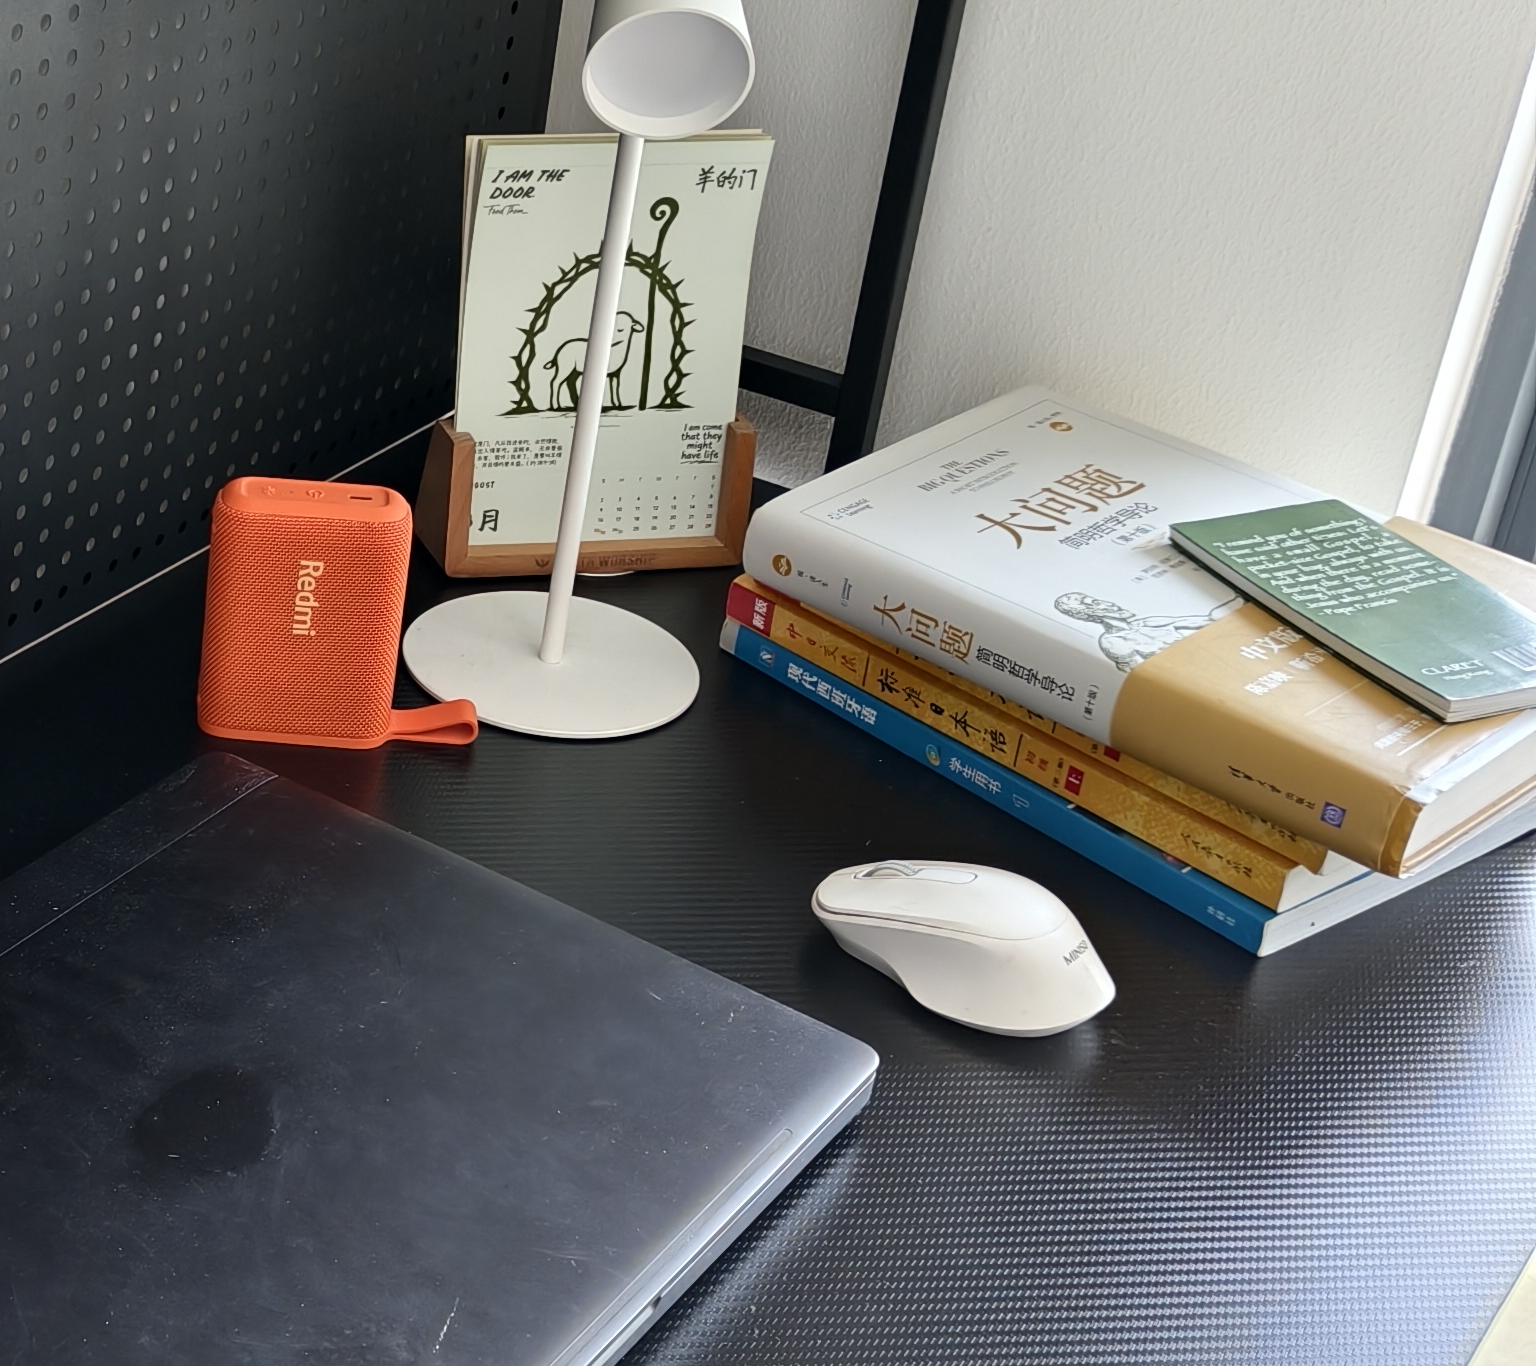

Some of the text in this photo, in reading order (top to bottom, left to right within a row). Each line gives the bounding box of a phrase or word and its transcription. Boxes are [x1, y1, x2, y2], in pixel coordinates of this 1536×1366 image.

[491, 169, 570, 183] I AM THE
[695, 165, 757, 193] 羊的门
[681, 432, 722, 442] that they
[686, 441, 713, 452] might
[680, 450, 719, 461] have life
[917, 449, 1011, 492] BIG QUESTIONS
[939, 460, 963, 471] THE
[975, 463, 1147, 550] 大问题
[1058, 502, 1158, 550] 简明哲学导论
[292, 560, 324, 637] Redmi
[752, 597, 769, 630] 新版
[785, 621, 859, 675] 中日交流
[873, 594, 975, 665] 大问题
[975, 645, 1076, 702] 简明哲学导论
[1240, 626, 1303, 660] 中文版
[1421, 659, 1484, 675] CLARET
[786, 662, 879, 726] 现代西班牙语
[875, 667, 1009, 754] 标准日本语
[948, 756, 1003, 795] 学生用书
